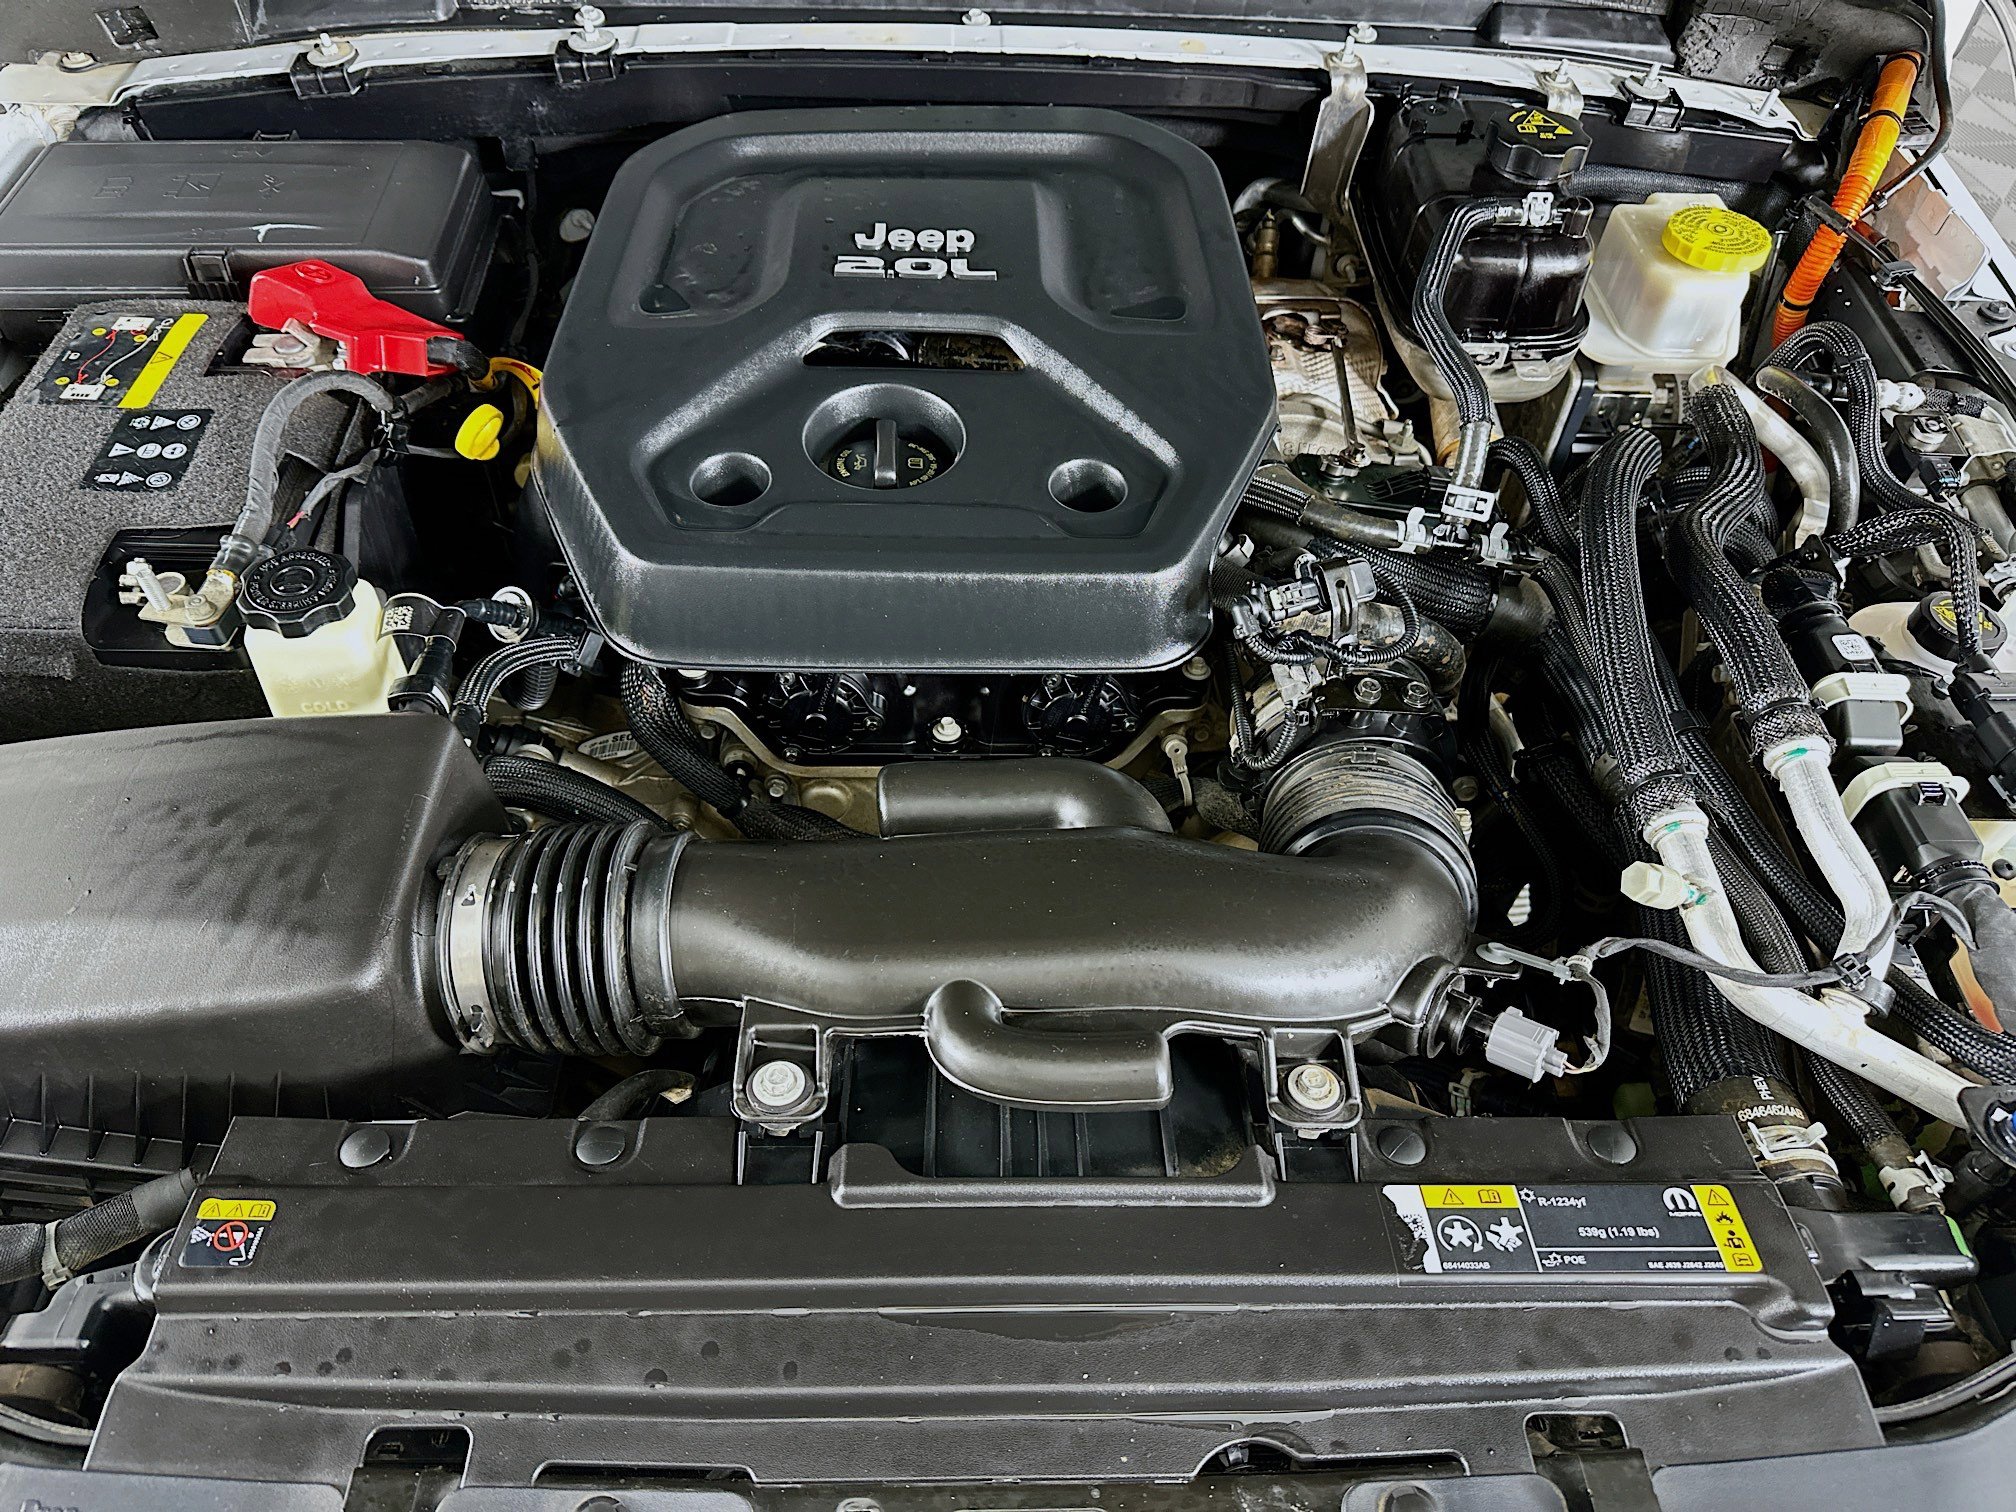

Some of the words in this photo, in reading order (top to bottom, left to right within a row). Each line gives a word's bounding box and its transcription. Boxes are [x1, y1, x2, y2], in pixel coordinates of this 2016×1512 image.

[854, 222, 975, 257] Jeep
[834, 255, 998, 281] 2.0L
[836, 457, 851, 478] ENGINE
[301, 701, 350, 714] COLD
[1751, 1074, 1775, 1100] PHEV
[1538, 1196, 1587, 1208] R-1234yf
[1577, 1226, 1608, 1239] 539g
[1608, 1226, 1635, 1239] (1.19
[1636, 1226, 1660, 1239] lbs)
[1564, 1255, 1587, 1265] POE
